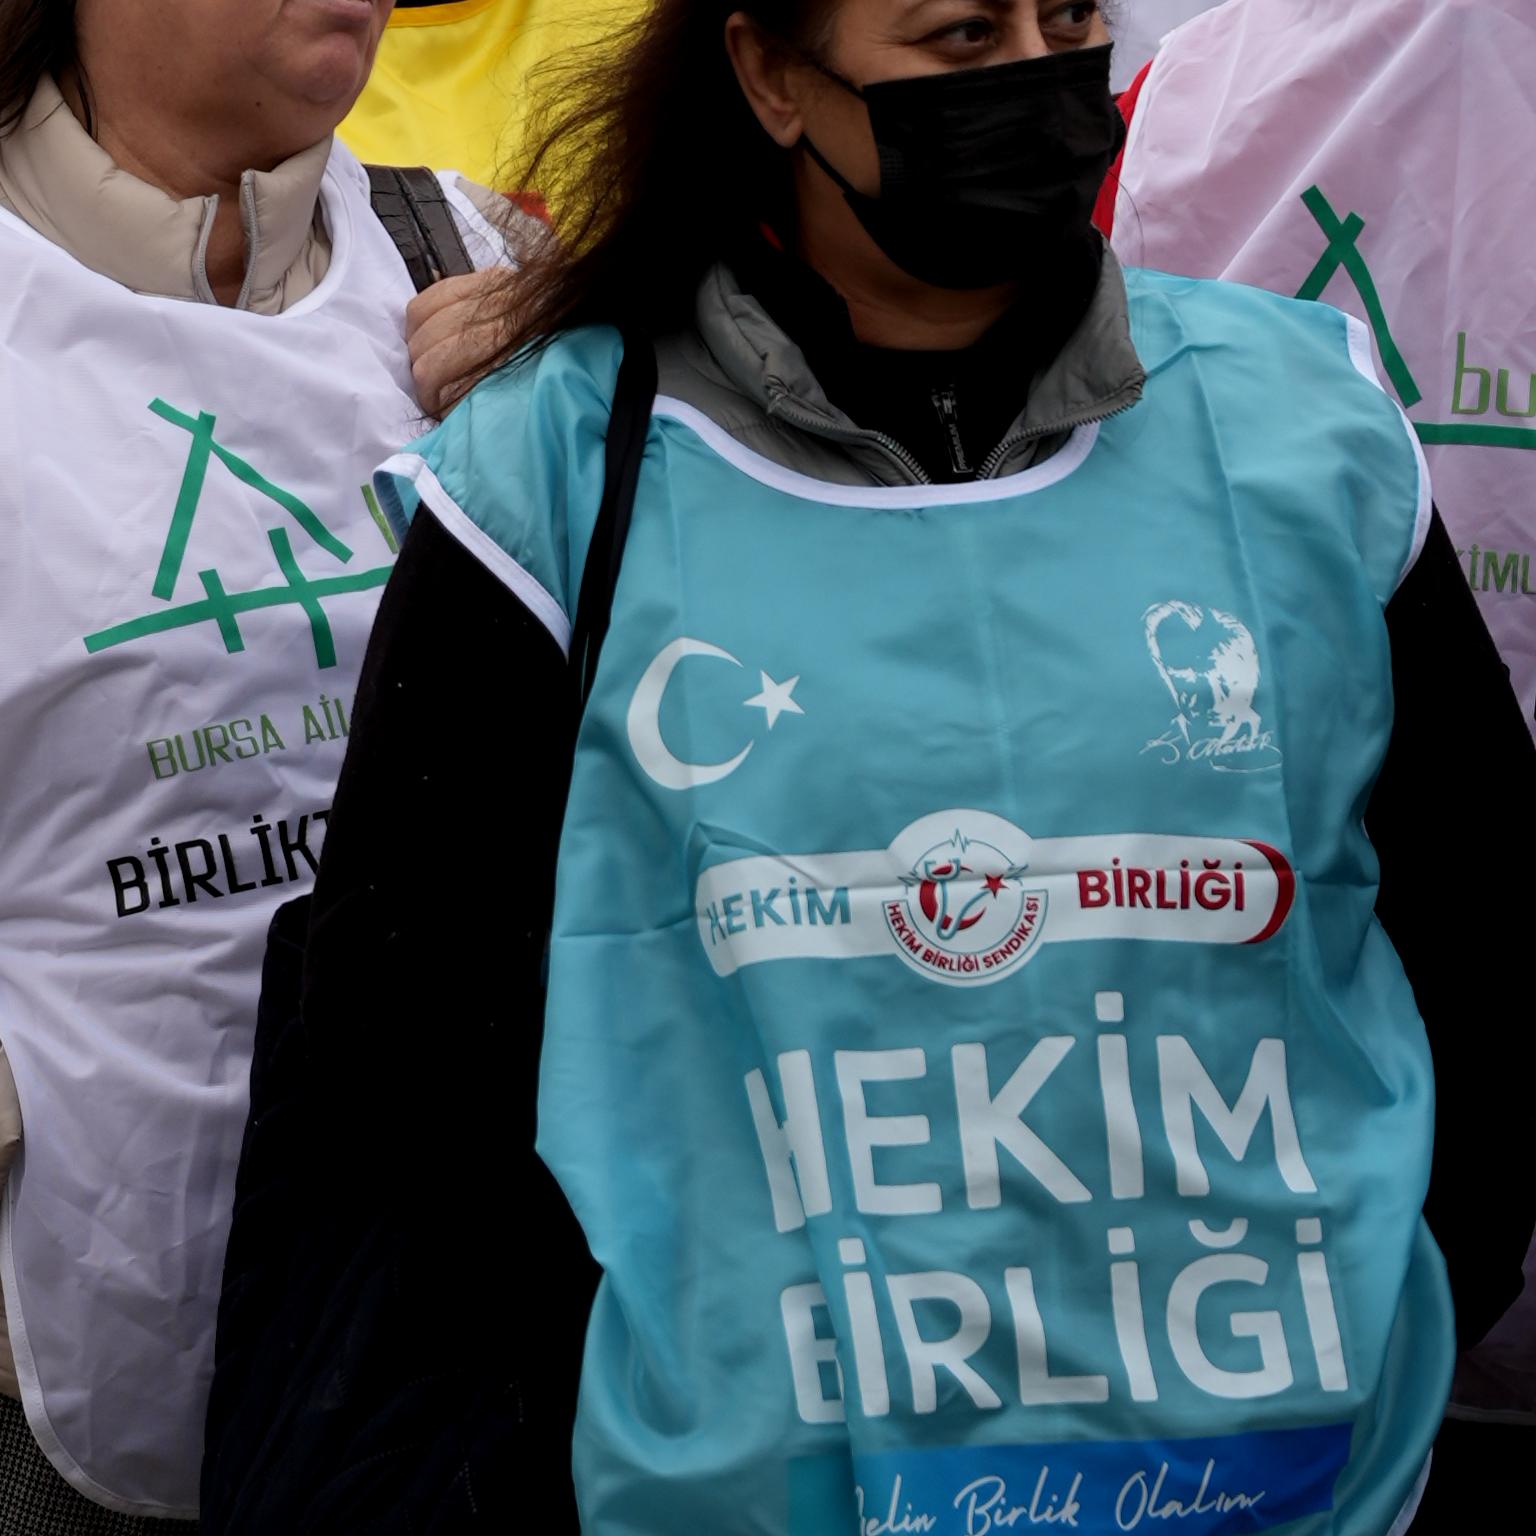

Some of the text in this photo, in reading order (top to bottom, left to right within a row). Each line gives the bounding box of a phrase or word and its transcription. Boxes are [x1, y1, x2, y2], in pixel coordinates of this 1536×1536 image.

[1457, 543, 1536, 594] İML
[146, 713, 286, 780] BURSA
[707, 857, 1245, 946] HEKİM BİRLİĞİ
[887, 896, 1040, 972] HEKİM BİRLİĞİ SENDİKASI
[744, 991, 1318, 1233] HEKİM
[779, 1216, 1349, 1425] BİRLİĞİ
